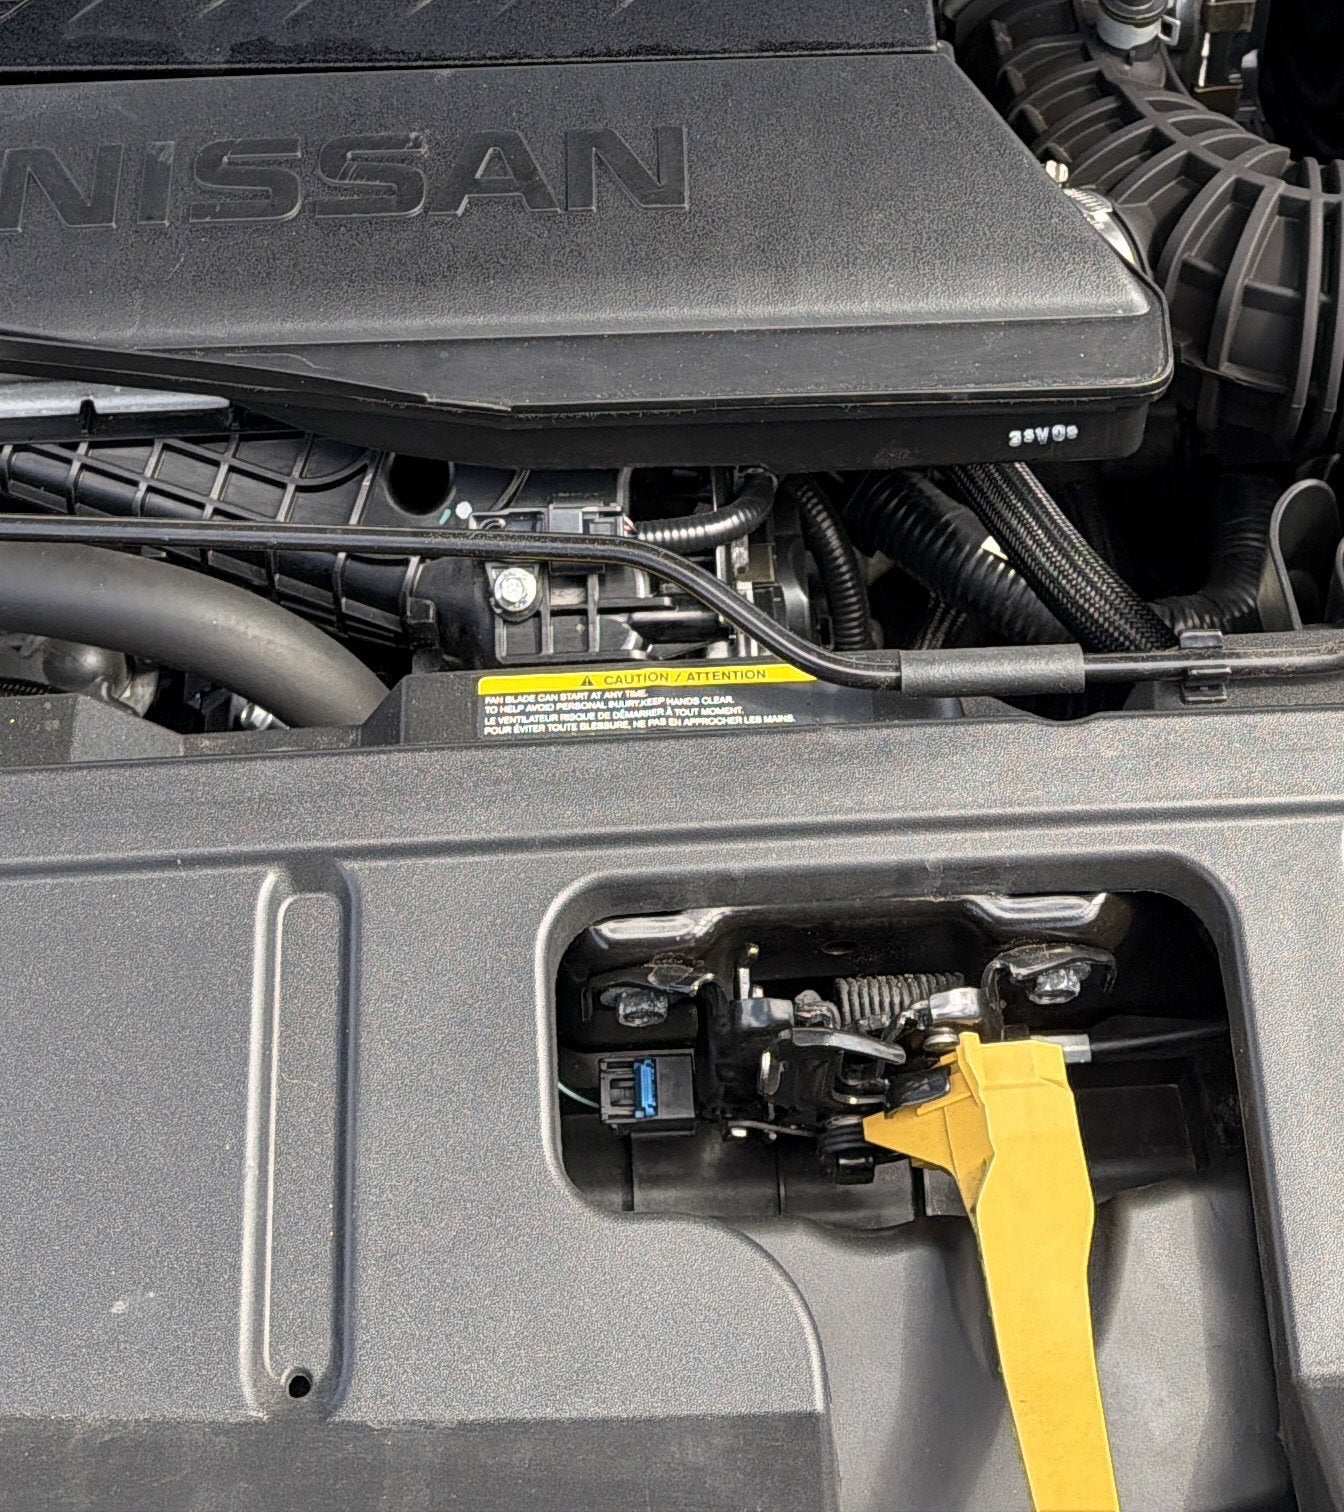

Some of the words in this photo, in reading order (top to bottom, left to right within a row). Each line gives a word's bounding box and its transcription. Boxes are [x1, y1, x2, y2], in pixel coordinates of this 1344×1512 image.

[603, 671, 669, 686] CAUTION
[674, 672, 682, 682] /
[686, 669, 767, 682] ATTENTION
[484, 695, 504, 704] FAN
[504, 694, 536, 704] BLADE
[537, 693, 558, 702] CAN
[560, 691, 588, 701] START
[590, 691, 602, 699] AT
[604, 690, 623, 699] ANY
[625, 689, 649, 698] TIME.
[484, 705, 498, 714] TO
[500, 704, 524, 713] HELP
[525, 703, 554, 712] AVOID
[556, 701, 607, 711] PERSONAL
[666, 696, 700, 706] HANDS
[701, 695, 735, 705] CLEAR.
[484, 717, 497, 726] LE
[498, 714, 559, 724] VENTILATEUR
[560, 712, 596, 722] RISQUE
[597, 711, 611, 720] DE
[612, 707, 664, 719] DÉMARRER
[666, 705, 673, 716] À
[674, 707, 698, 716] TOUT
[700, 706, 744, 716] MOMENT.
[484, 726, 513, 735] POUR
[513, 723, 546, 734] ÉVITER
[547, 722, 578, 732] TOUTE
[579, 720, 631, 731] BLESSURE,
[632, 719, 646, 728] NE
[647, 718, 667, 727] PAS
[668, 717, 682, 726] EN
[683, 715, 743, 726] APPROCHER
[744, 715, 762, 724] LES
[763, 714, 797, 724] MAINS.
